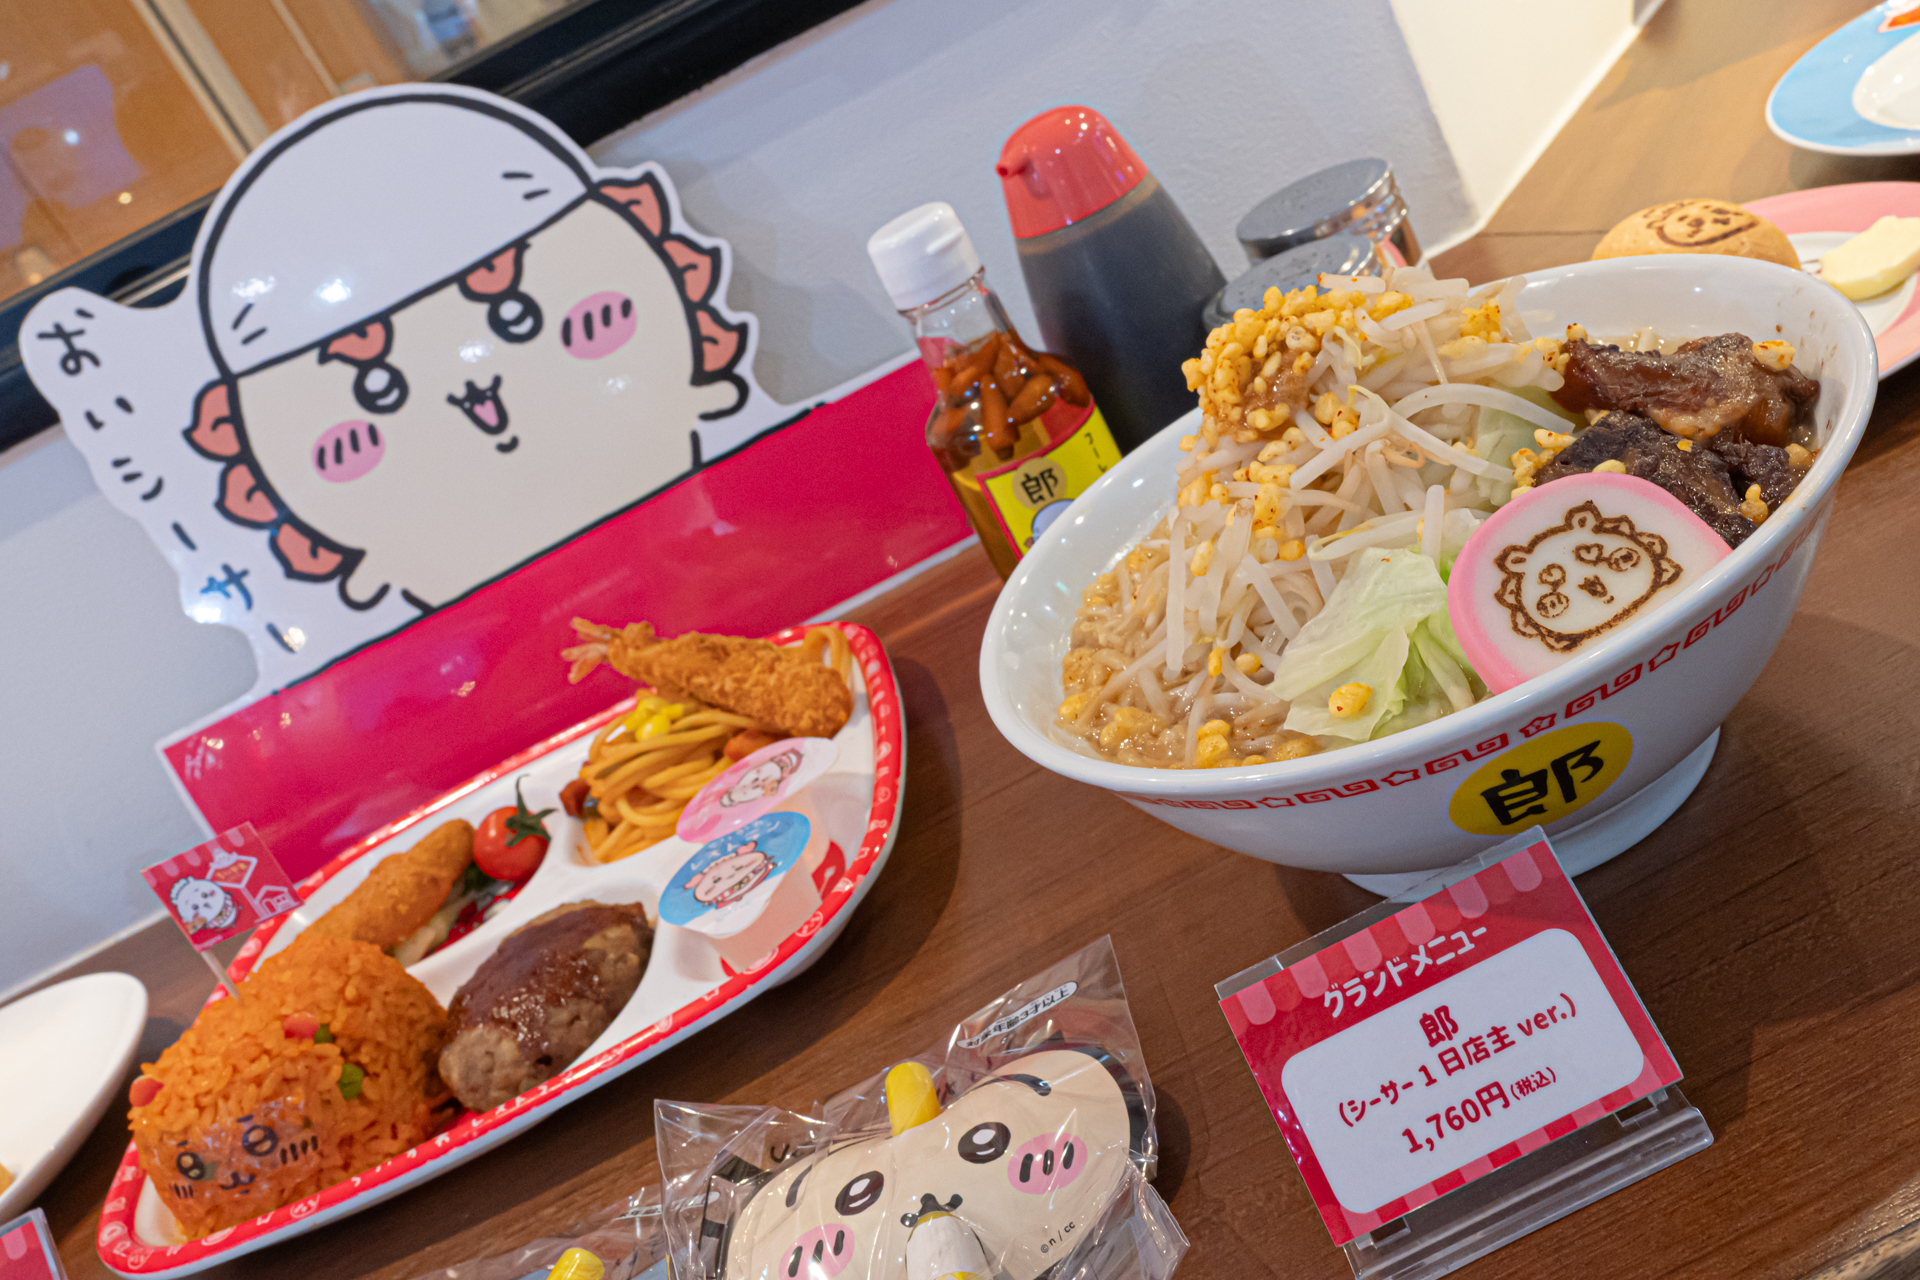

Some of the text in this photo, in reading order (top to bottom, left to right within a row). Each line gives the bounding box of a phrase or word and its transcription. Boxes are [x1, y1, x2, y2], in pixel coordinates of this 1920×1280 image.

[1021, 467, 1058, 504] 郎
[1480, 740, 1604, 826] 郎
[1324, 927, 1487, 1018] グランドメニュー
[1419, 1005, 1459, 1048] 郎
